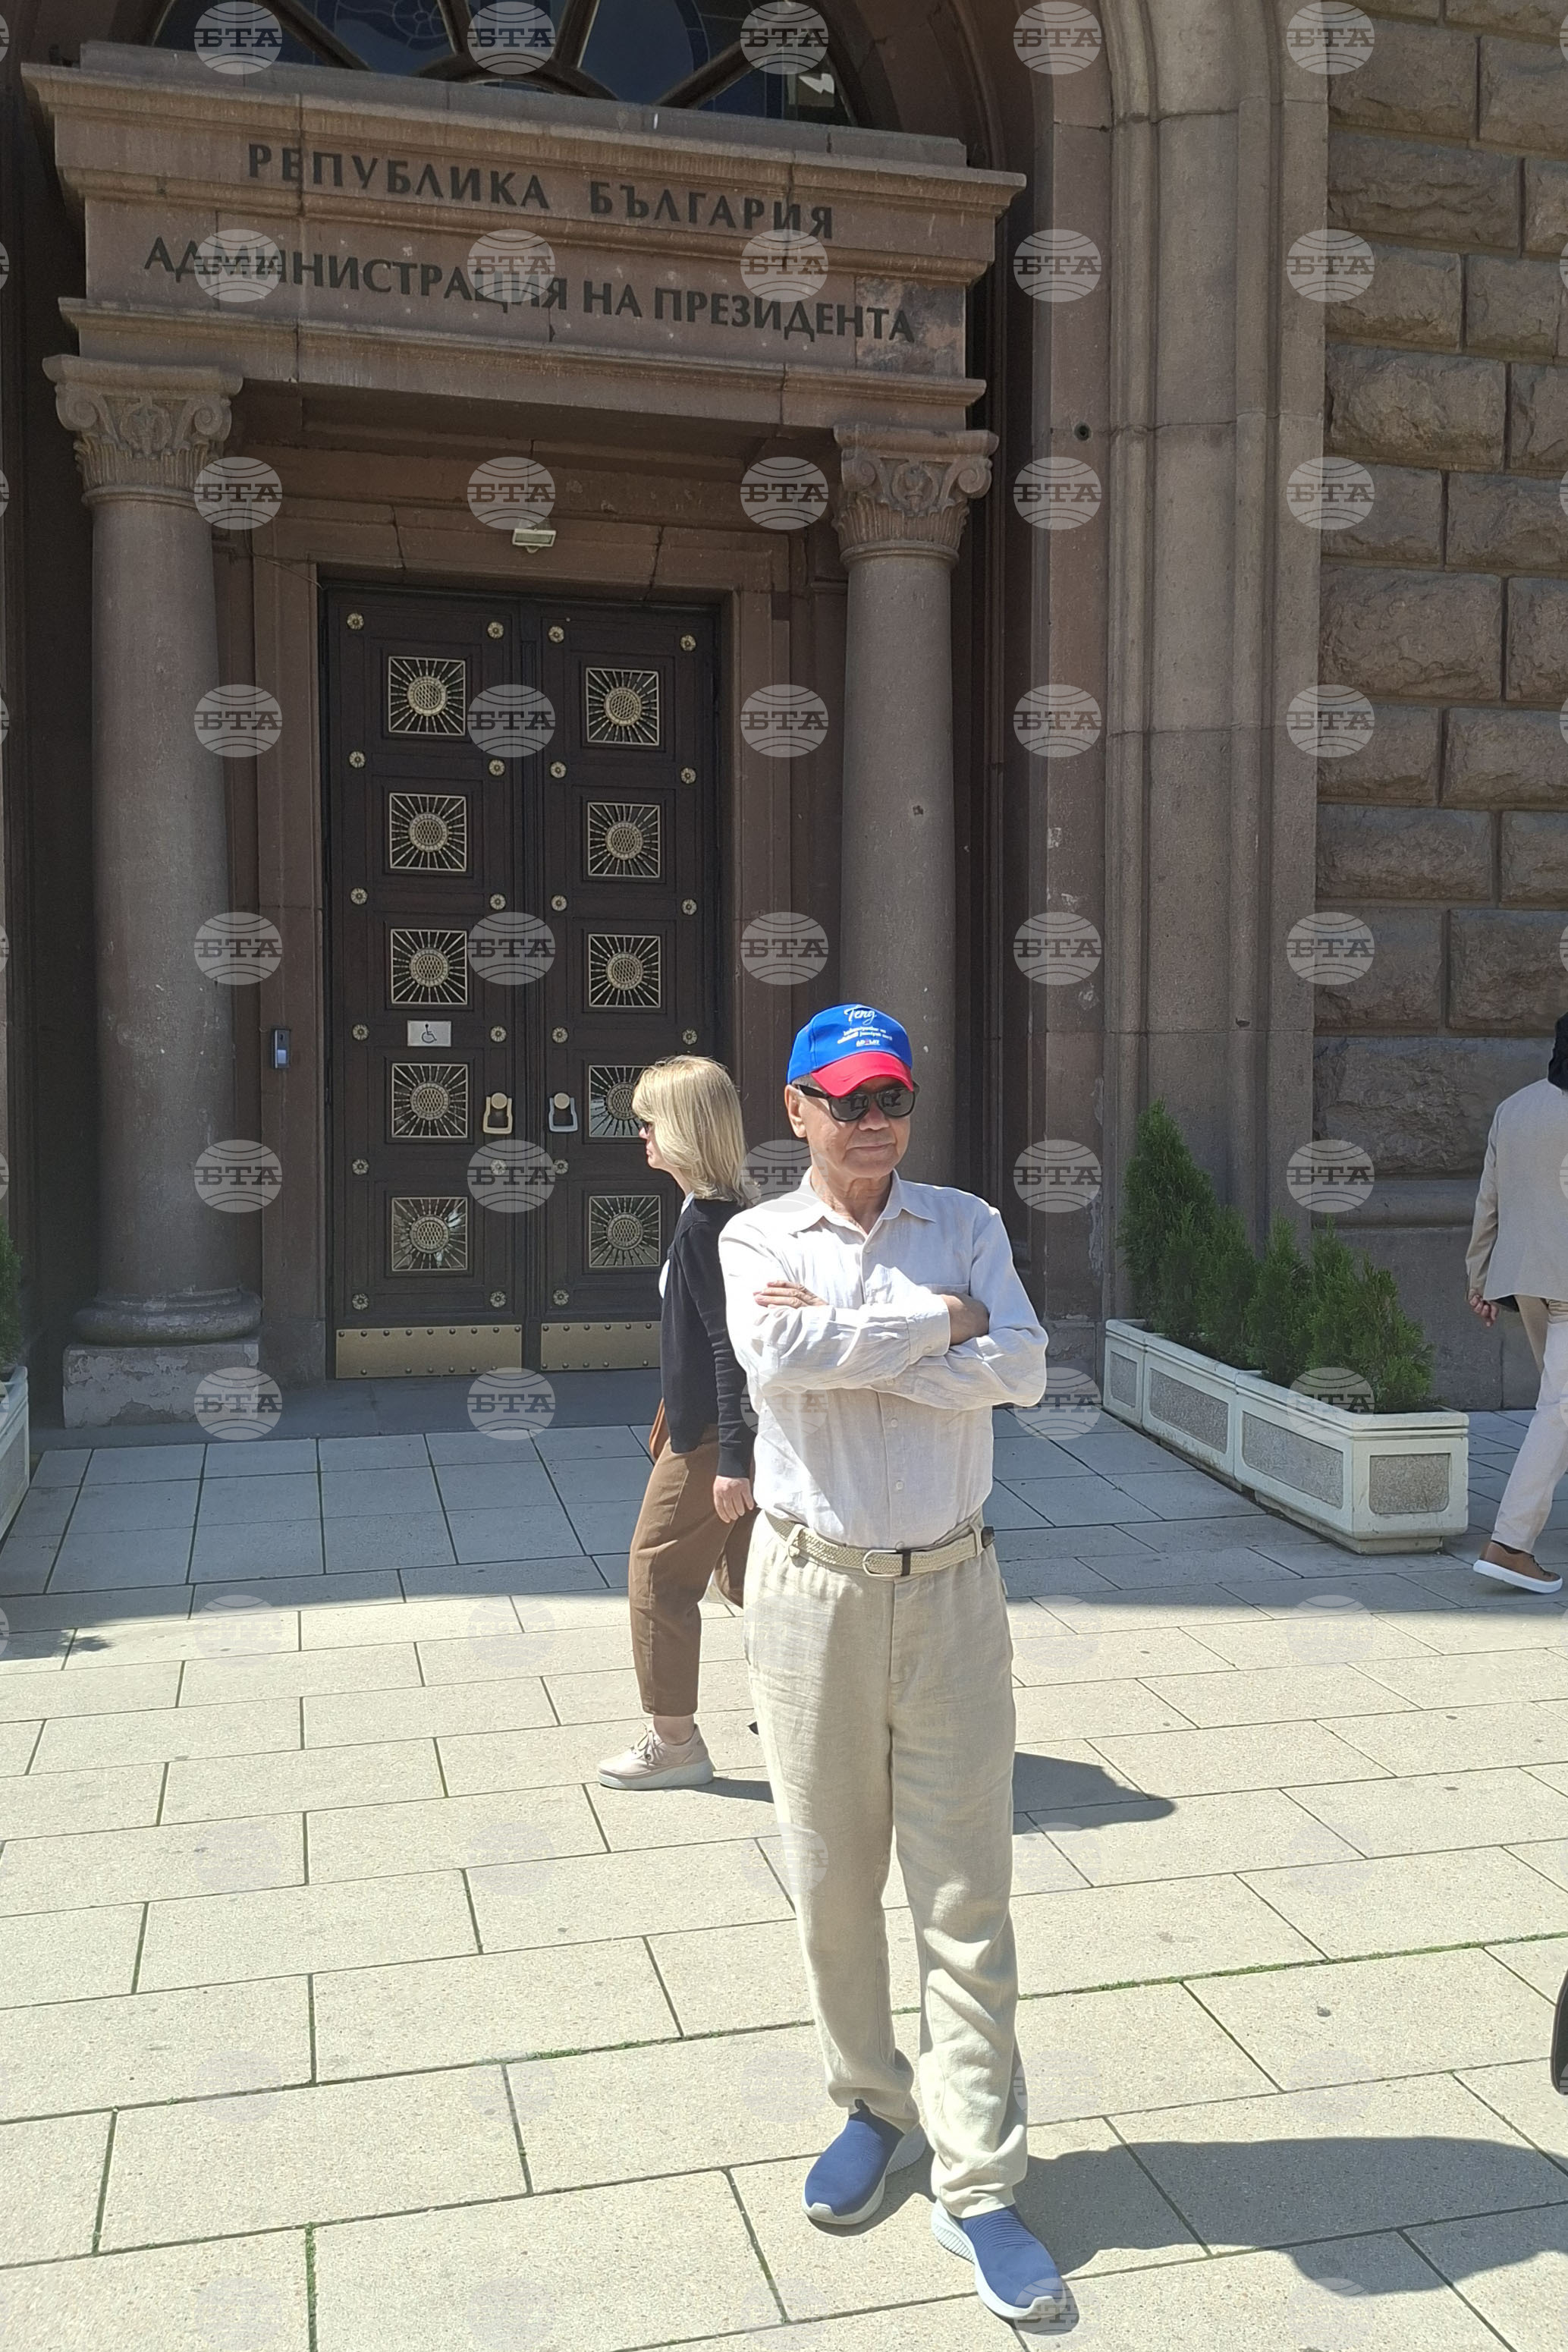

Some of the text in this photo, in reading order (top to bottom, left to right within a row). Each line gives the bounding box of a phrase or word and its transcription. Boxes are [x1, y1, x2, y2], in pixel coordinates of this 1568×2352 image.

[249, 143, 833, 239] РЕПУБЛИКА БЪЛГАРИЯ
[143, 236, 915, 342] АДМИНИСТРАЦИЯ НА ПРЕЗИДЕНТА
